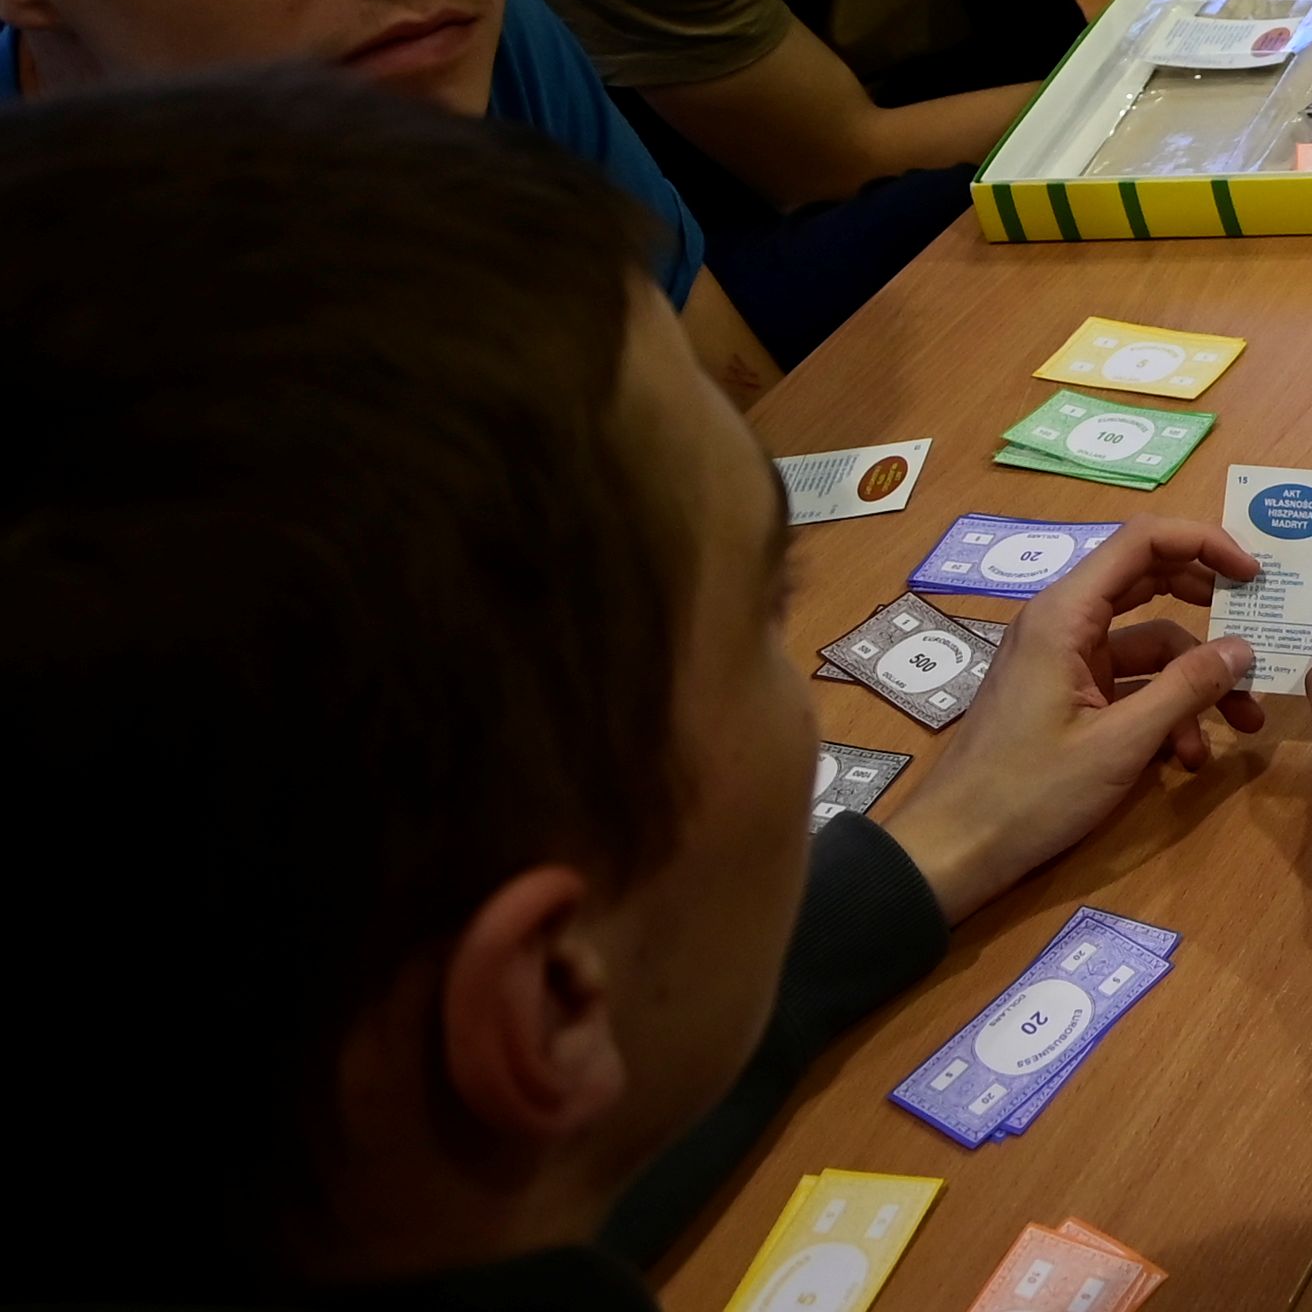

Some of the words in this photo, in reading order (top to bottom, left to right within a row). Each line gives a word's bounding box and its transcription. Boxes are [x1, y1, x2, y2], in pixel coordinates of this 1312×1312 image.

[1096, 429, 1124, 445] 100
[1237, 475, 1248, 484] 15
[1282, 488, 1301, 499] AKT
[1271, 517, 1308, 531] MADRYT
[1019, 549, 1042, 562] 20
[907, 648, 937, 676] 500
[1071, 947, 1086, 963] 20
[988, 994, 1027, 1028] DOLLARS
[1018, 1007, 1049, 1039] 20
[1016, 1008, 1083, 1069] EUROBUSINESS
[979, 1089, 996, 1108] 20
